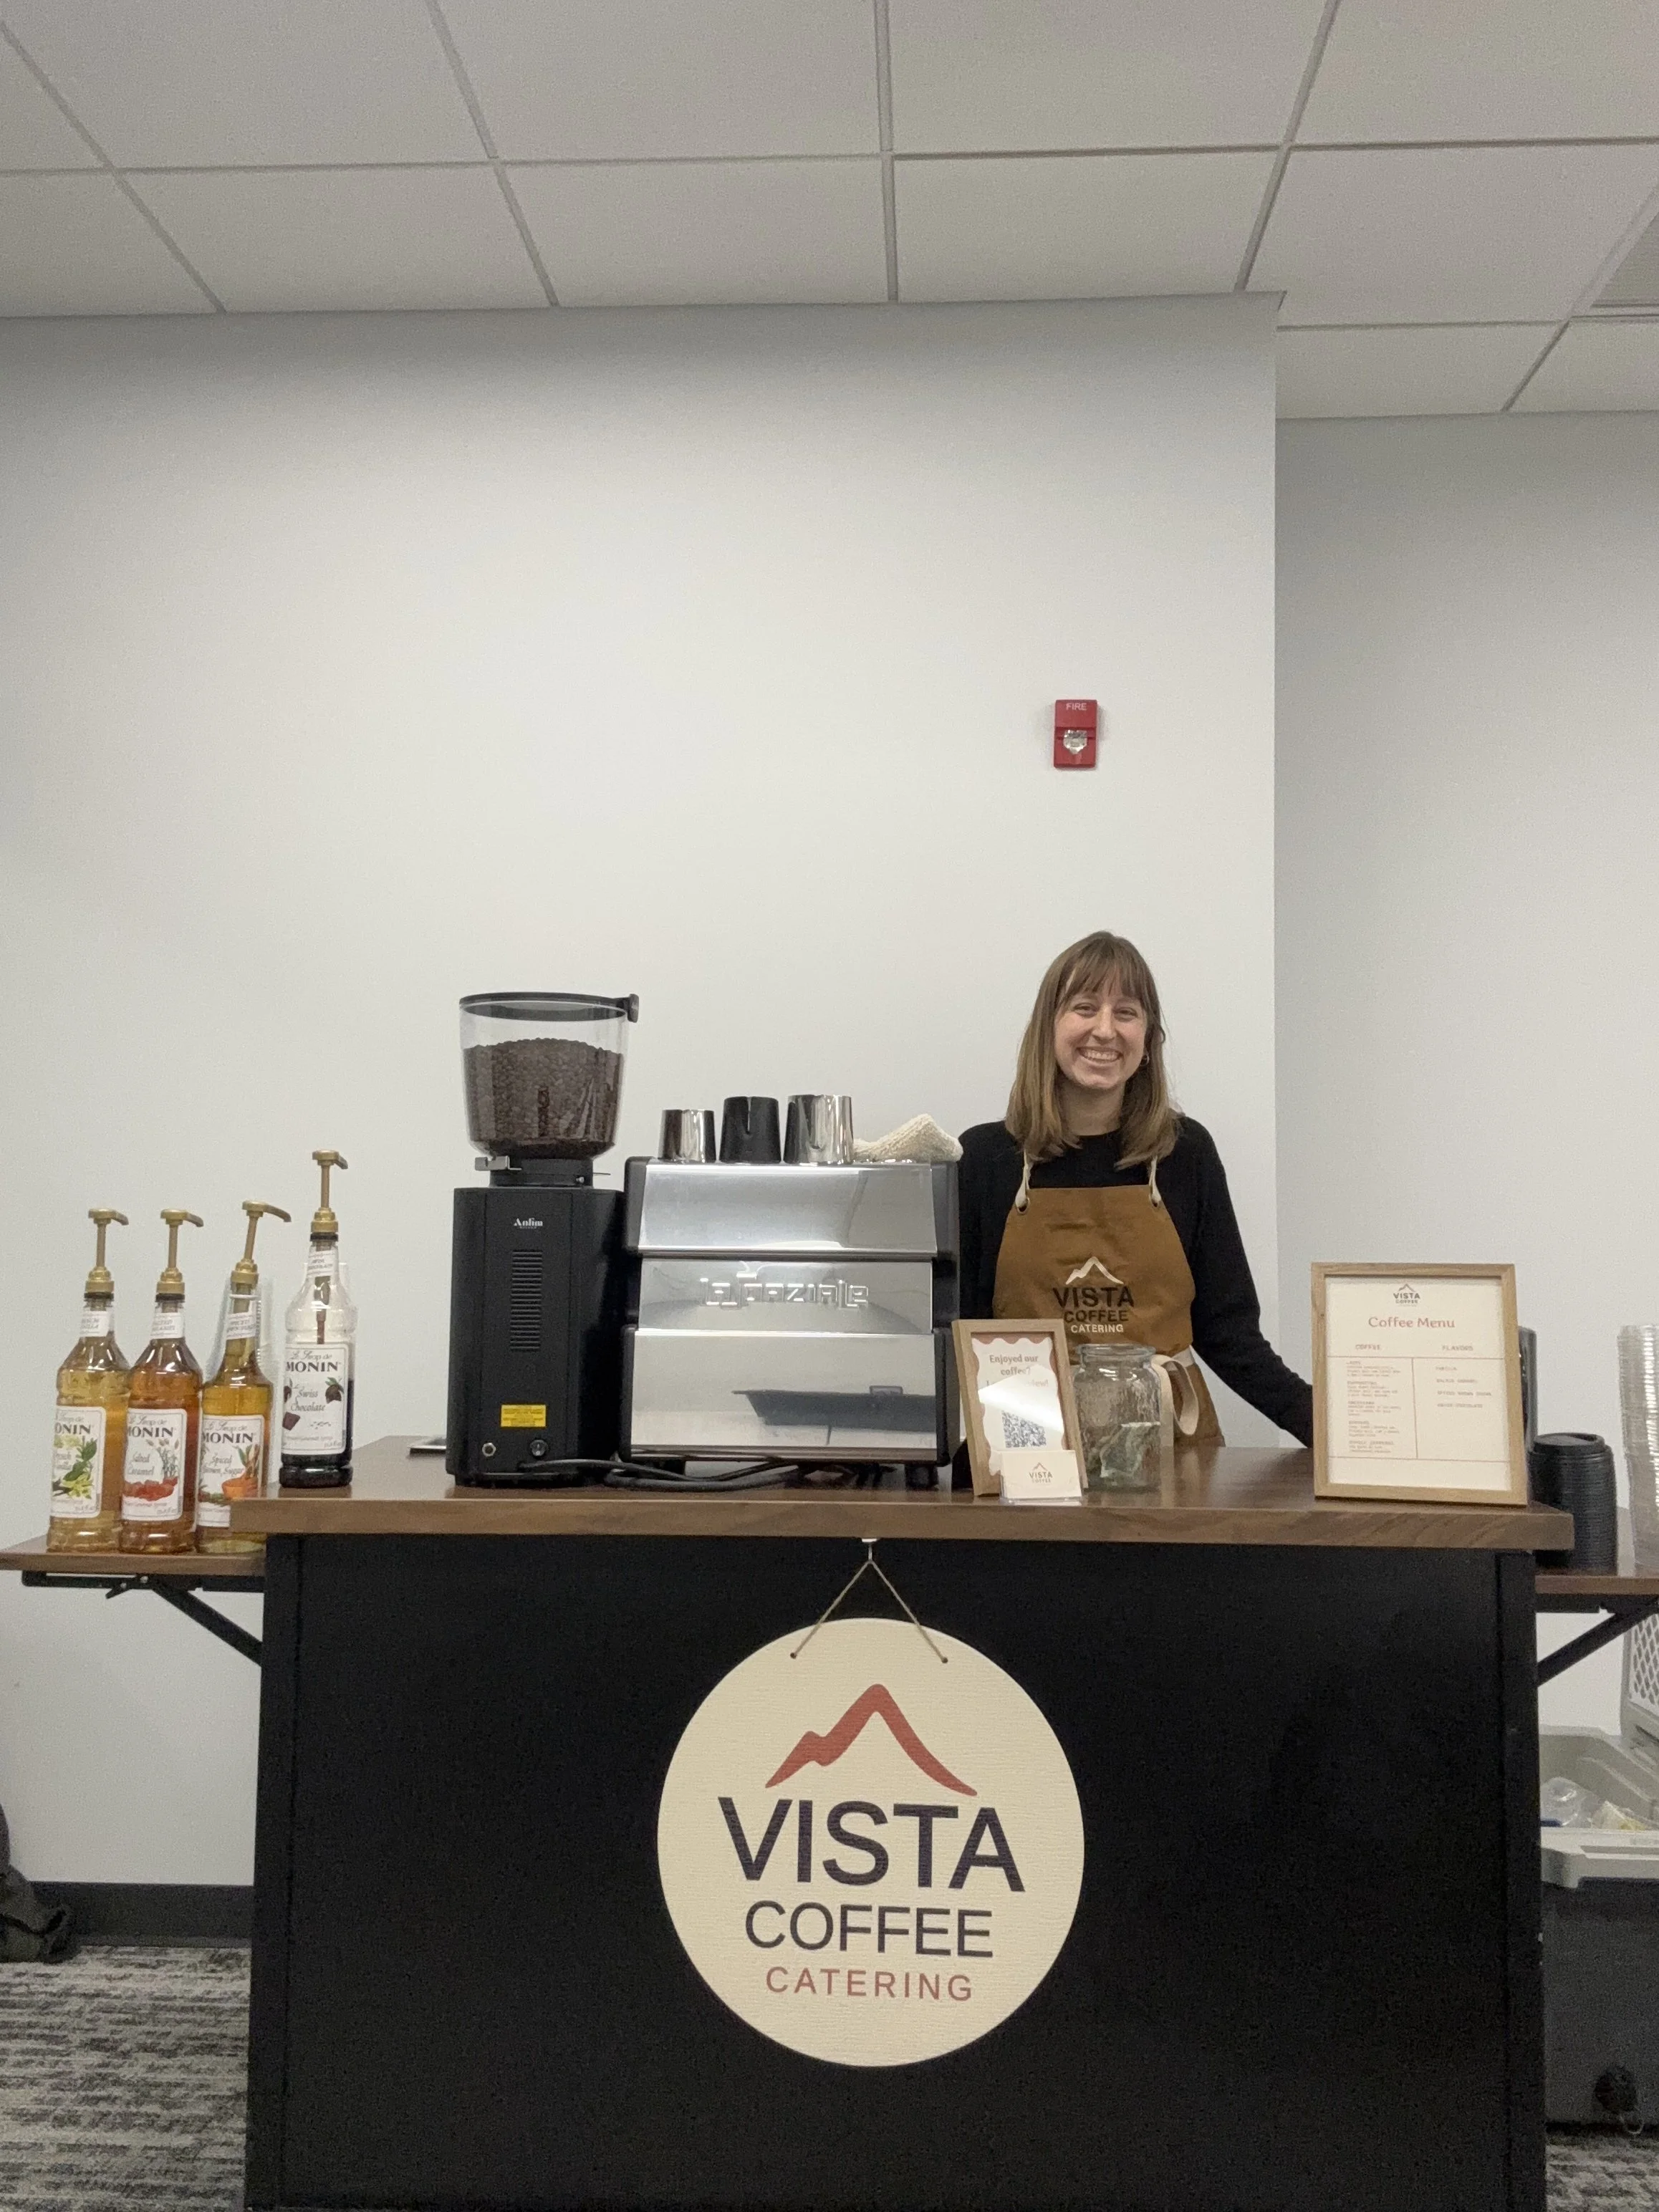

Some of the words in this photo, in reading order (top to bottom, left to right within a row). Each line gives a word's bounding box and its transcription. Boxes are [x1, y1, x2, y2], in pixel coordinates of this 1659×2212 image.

[1052, 1287, 1135, 1308] VISTA
[1064, 1309, 1130, 1323] COFFEE
[1368, 1317, 1413, 1328] Coffee
[1417, 1317, 1456, 1328] Menu
[1070, 1324, 1125, 1332] CATERING
[989, 1355, 1022, 1365] Enjoyed
[718, 1797, 1025, 1892] VISTA
[746, 1900, 993, 1958] COFFEE
[766, 1966, 972, 2001] CATERING
